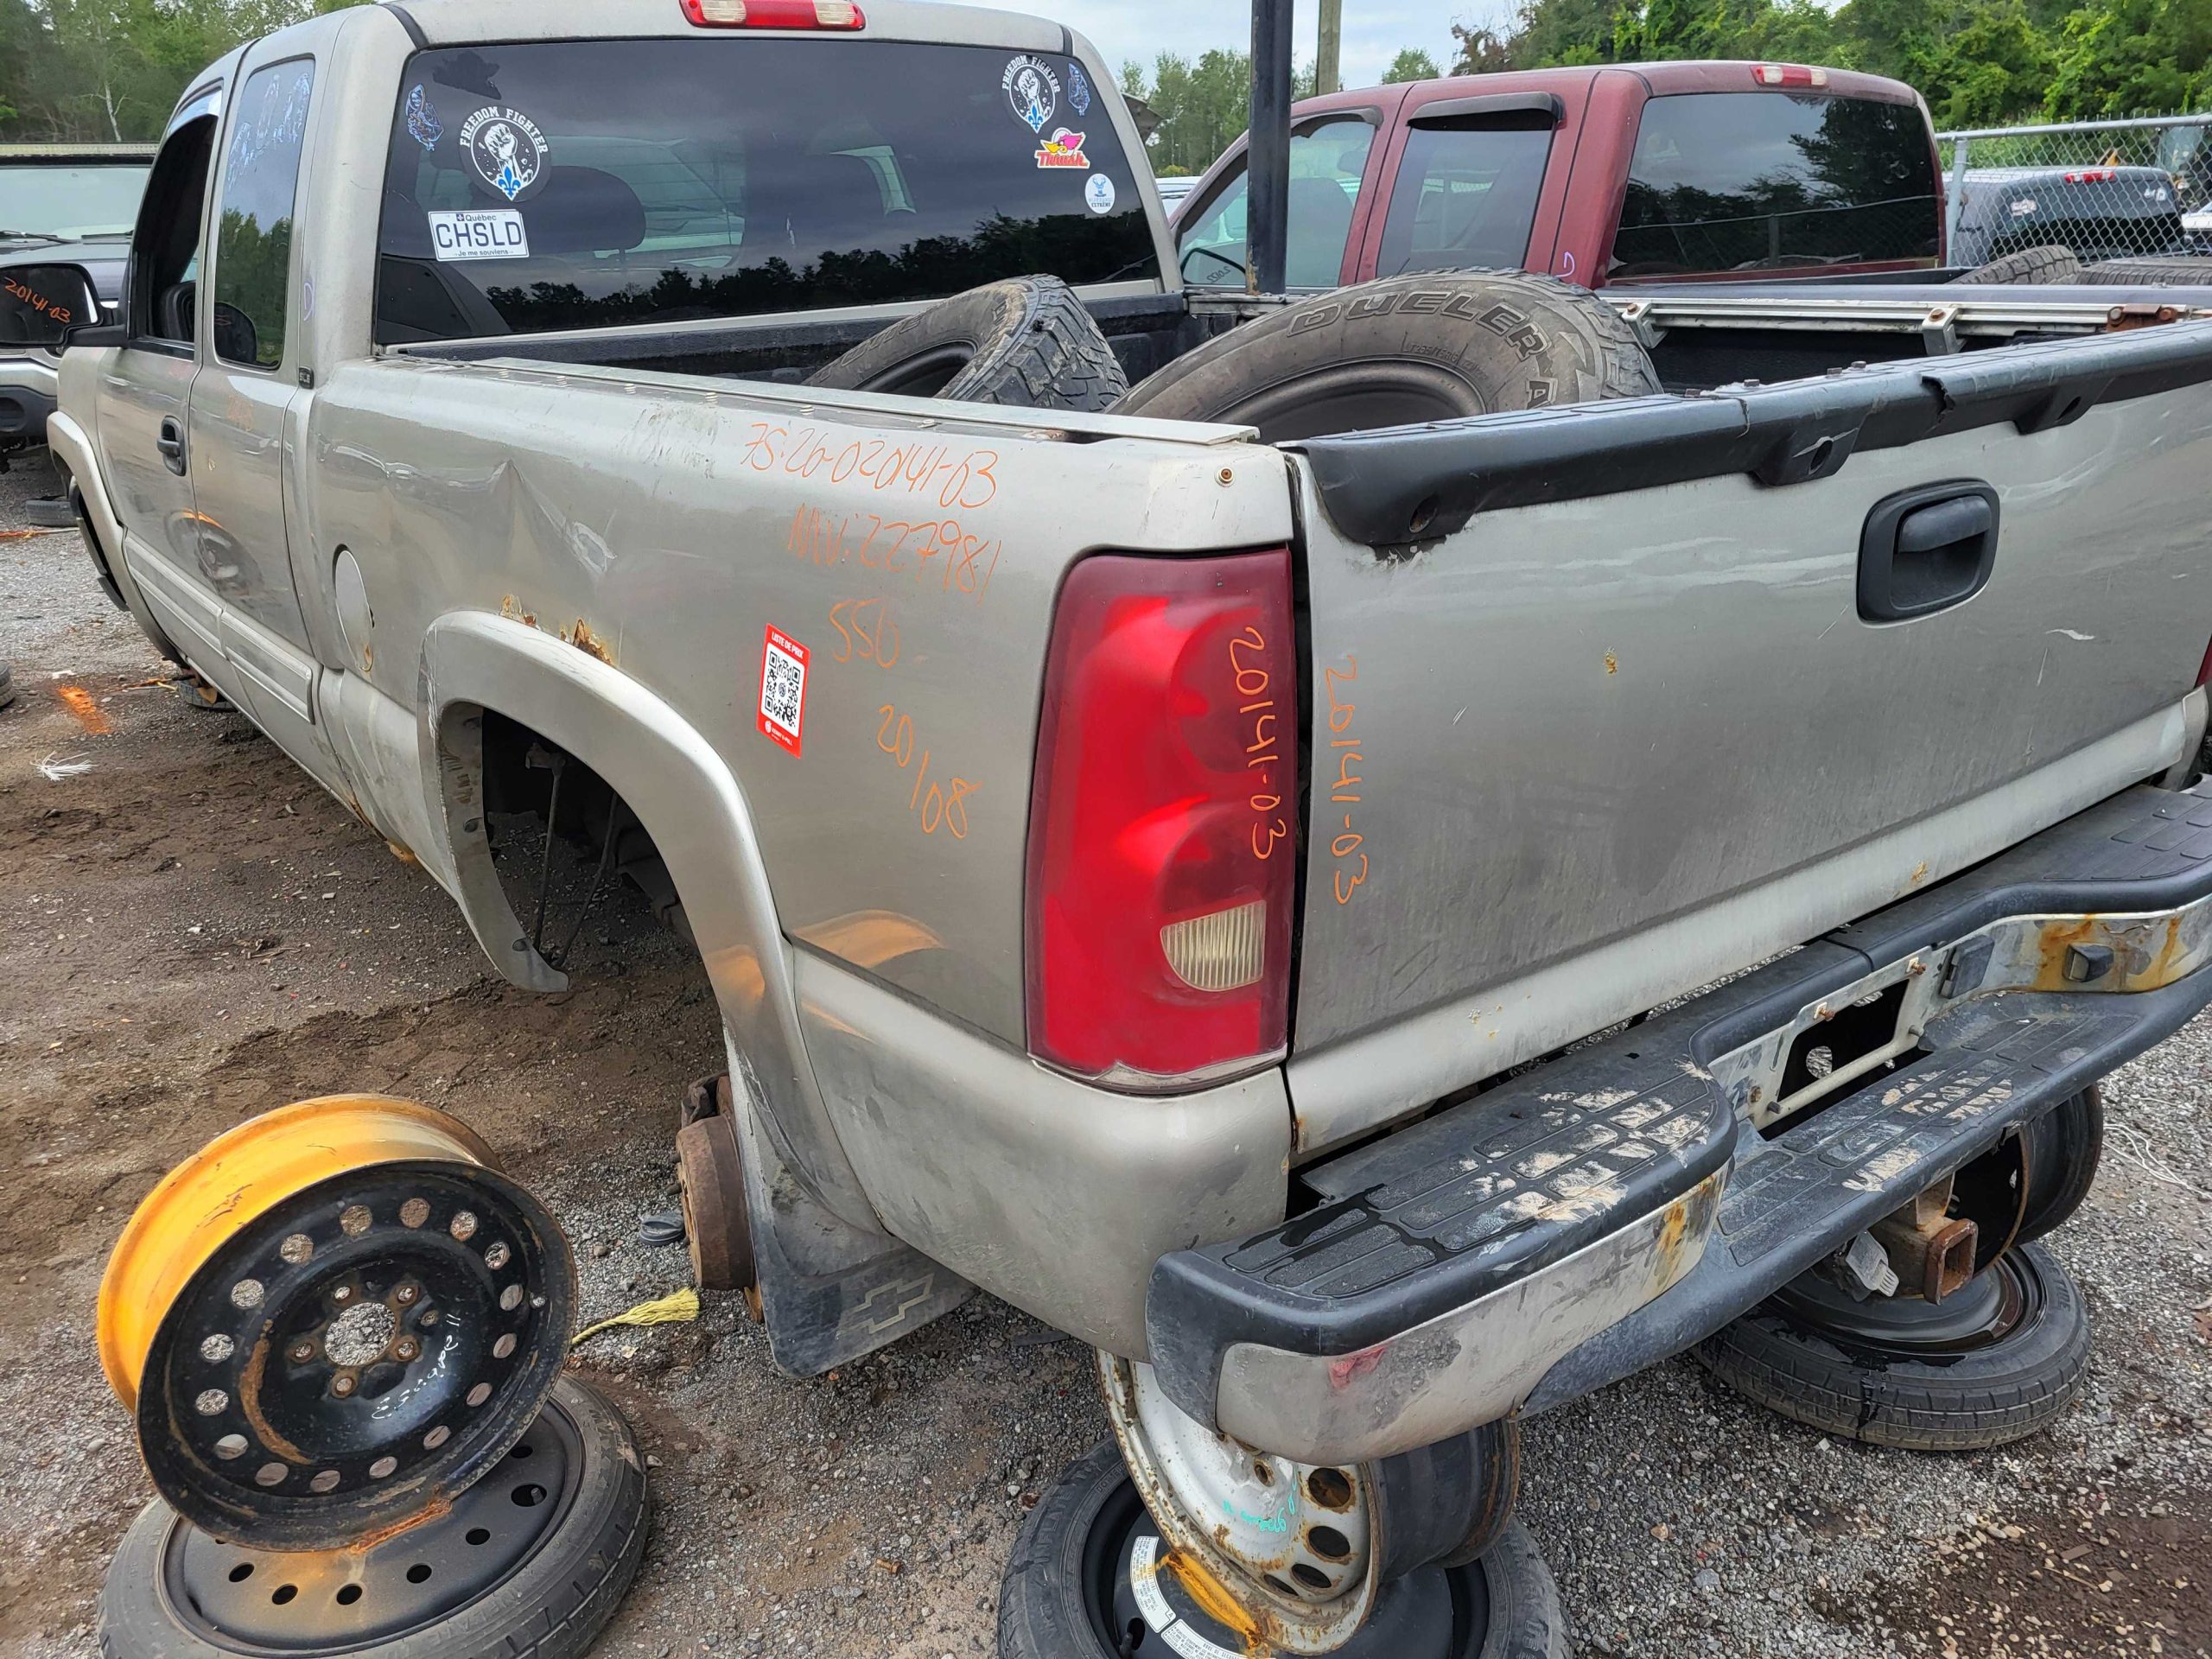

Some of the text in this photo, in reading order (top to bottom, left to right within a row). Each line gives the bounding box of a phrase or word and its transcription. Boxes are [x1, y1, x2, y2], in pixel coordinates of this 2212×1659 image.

[1001, 54, 1061, 93] FREEDOM FIGHTER
[460, 105, 549, 154] FREEDOM FIGHTER
[435, 221, 523, 249] CHSLD
[465, 213, 497, 222] Québec
[3, 276, 71, 324] 20141-03
[1286, 289, 1552, 363] DUELER
[772, 631, 785, 647] LISTE
[791, 645, 804, 659] PRIX
[1230, 626, 1287, 860] 20141-03
[1326, 654, 1369, 904] 20141-03
